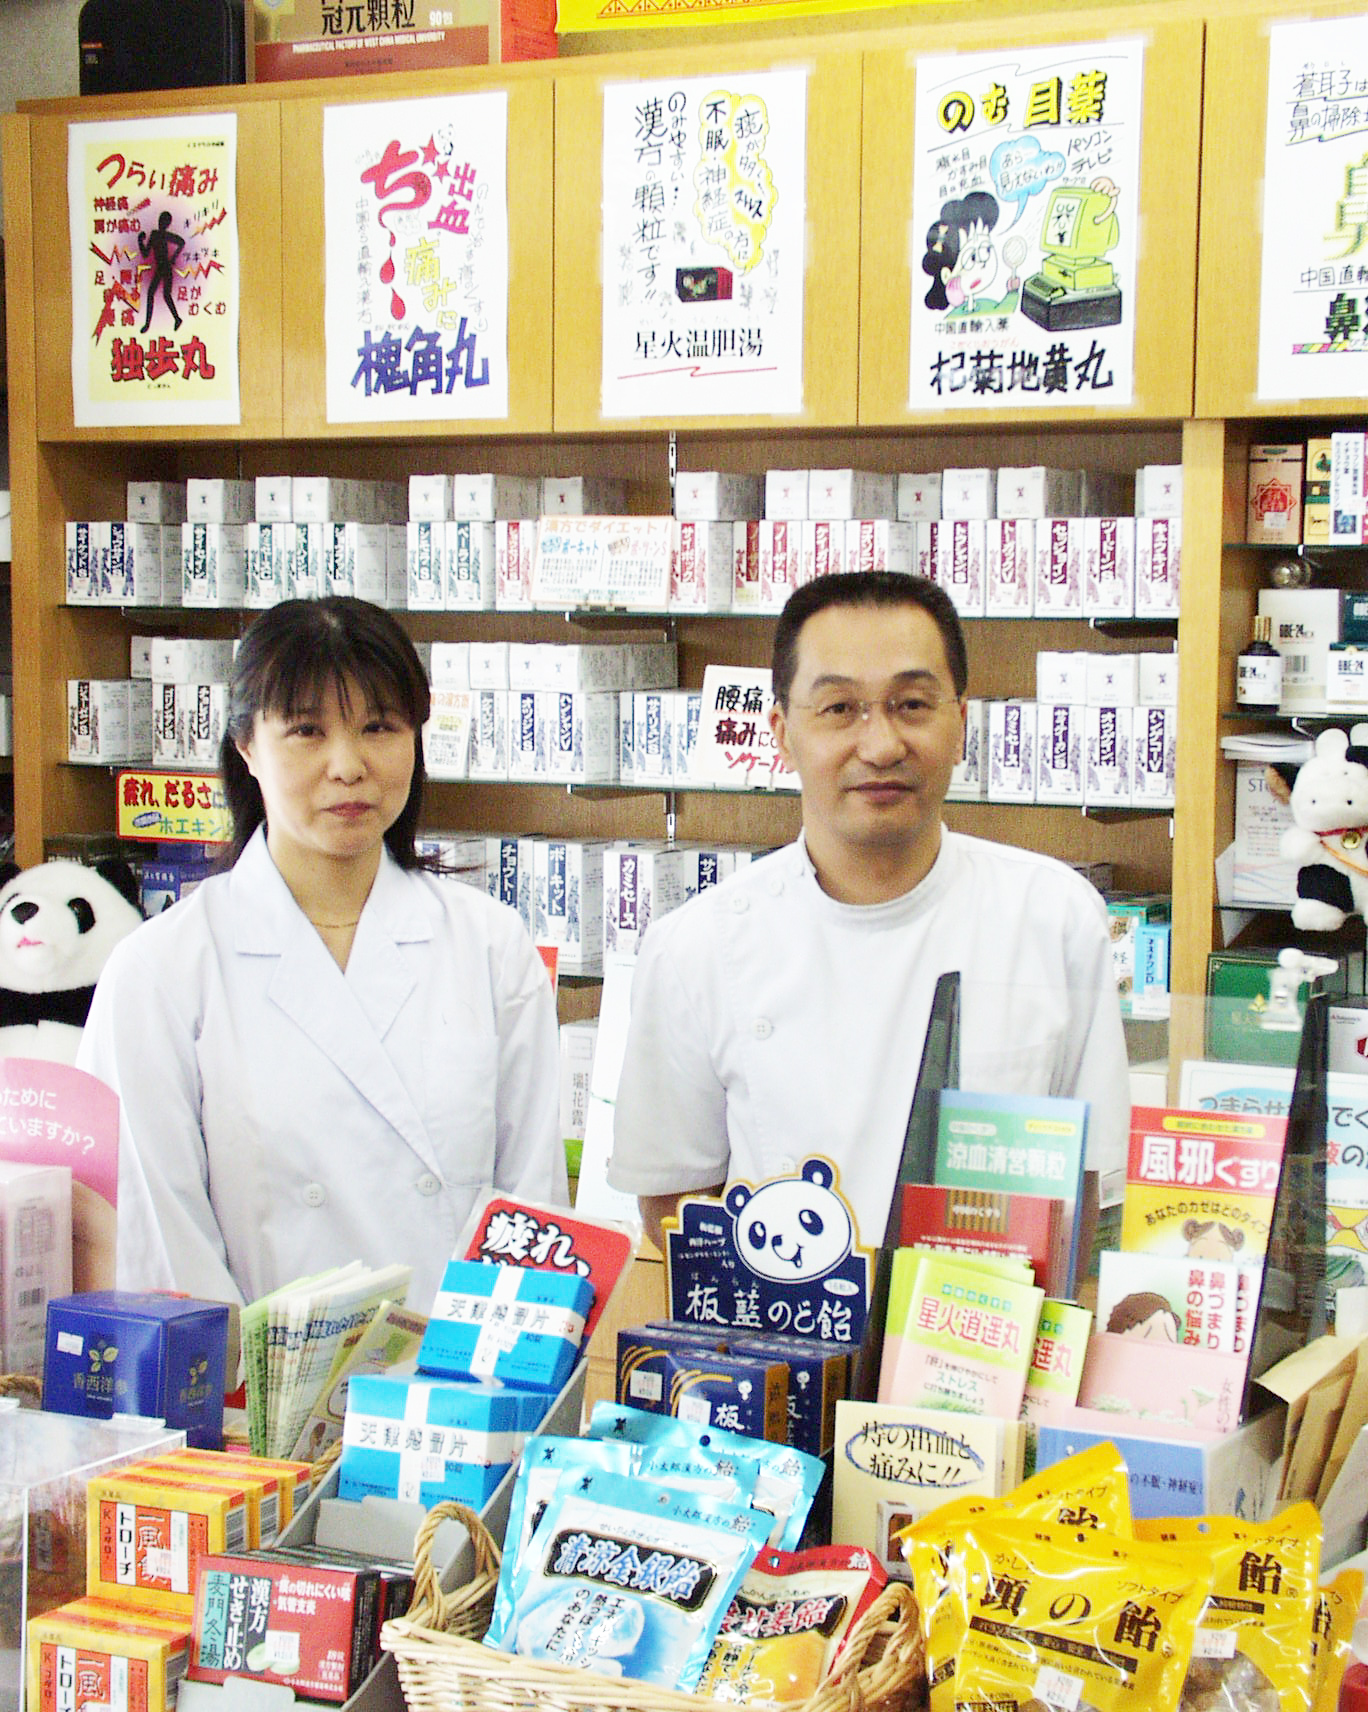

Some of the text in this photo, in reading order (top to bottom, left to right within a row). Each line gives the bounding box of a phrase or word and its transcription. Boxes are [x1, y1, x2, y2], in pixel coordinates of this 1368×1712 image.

[97, 153, 218, 197] つらい痛み
[428, 162, 477, 234] 出血
[635, 328, 762, 359] 星火温胆湯
[1323, 292, 1368, 345] 鼻
[111, 336, 215, 382] 独歩丸
[351, 317, 490, 397] 槐角丸
[930, 340, 1113, 396] 杞菊地黄丸
[0, 1087, 57, 1110] ために
[686, 1283, 852, 1342] 板藍のど飴
[120, 1511, 132, 1576] トローチ
[1238, 1550, 1283, 1595] 飴
[223, 1577, 249, 1670] せき止め
[249, 1578, 271, 1633] 漢方
